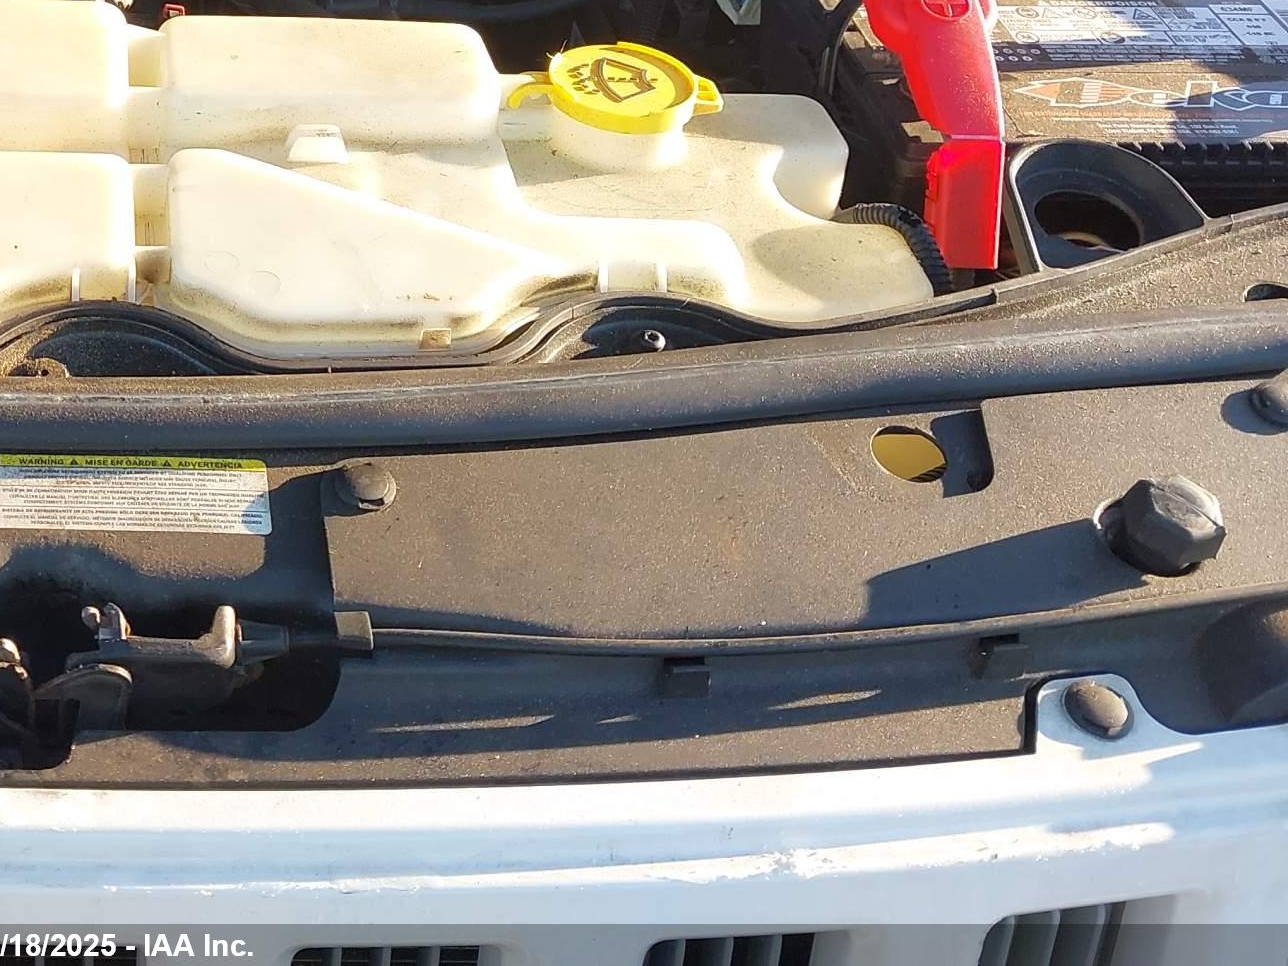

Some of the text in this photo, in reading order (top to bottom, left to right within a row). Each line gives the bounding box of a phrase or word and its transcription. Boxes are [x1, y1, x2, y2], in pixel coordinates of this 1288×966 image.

[19, 457, 64, 465] WARNING
[85, 458, 109, 466] MISE
[125, 459, 158, 467] GARDE
[178, 460, 243, 469] ADVERTENCIA
